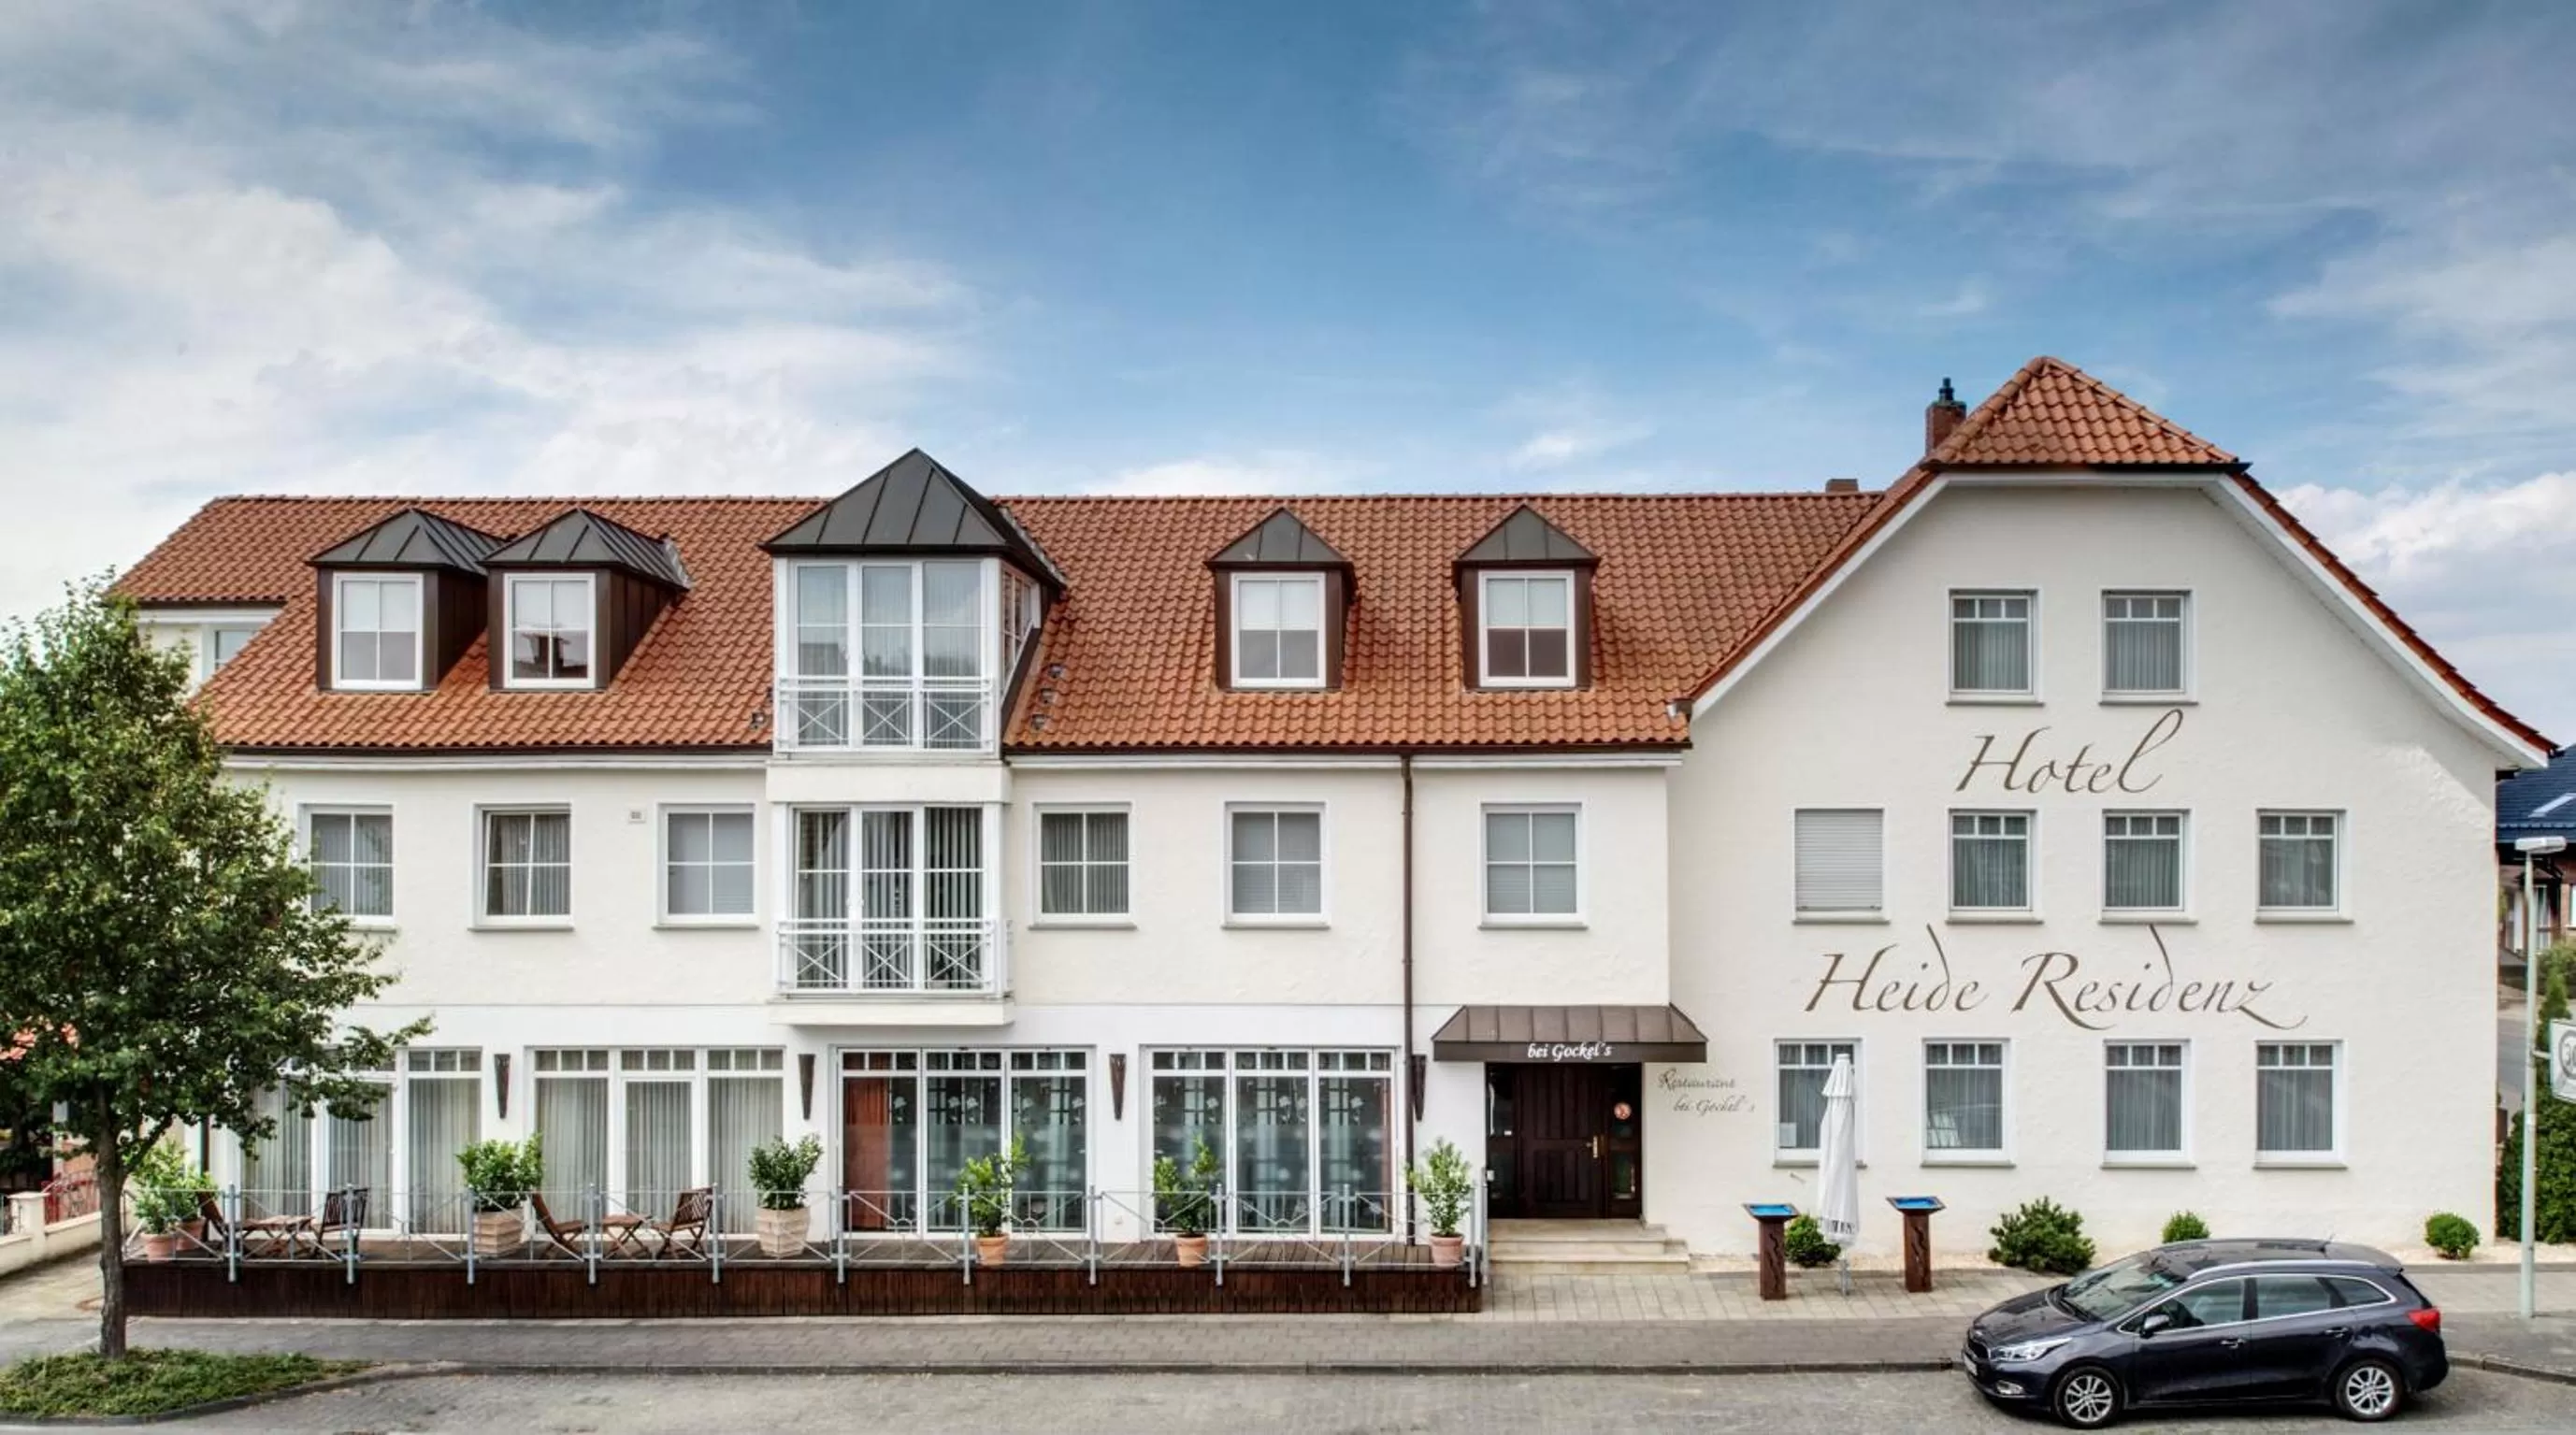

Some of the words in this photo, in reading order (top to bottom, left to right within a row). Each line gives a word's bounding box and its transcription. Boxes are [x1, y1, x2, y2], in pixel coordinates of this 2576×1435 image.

[1955, 709, 2183, 794] Hotel
[1805, 923, 1990, 1012] Heide
[2009, 923, 2308, 1030] Residenz
[1527, 1042, 1548, 1058] bei
